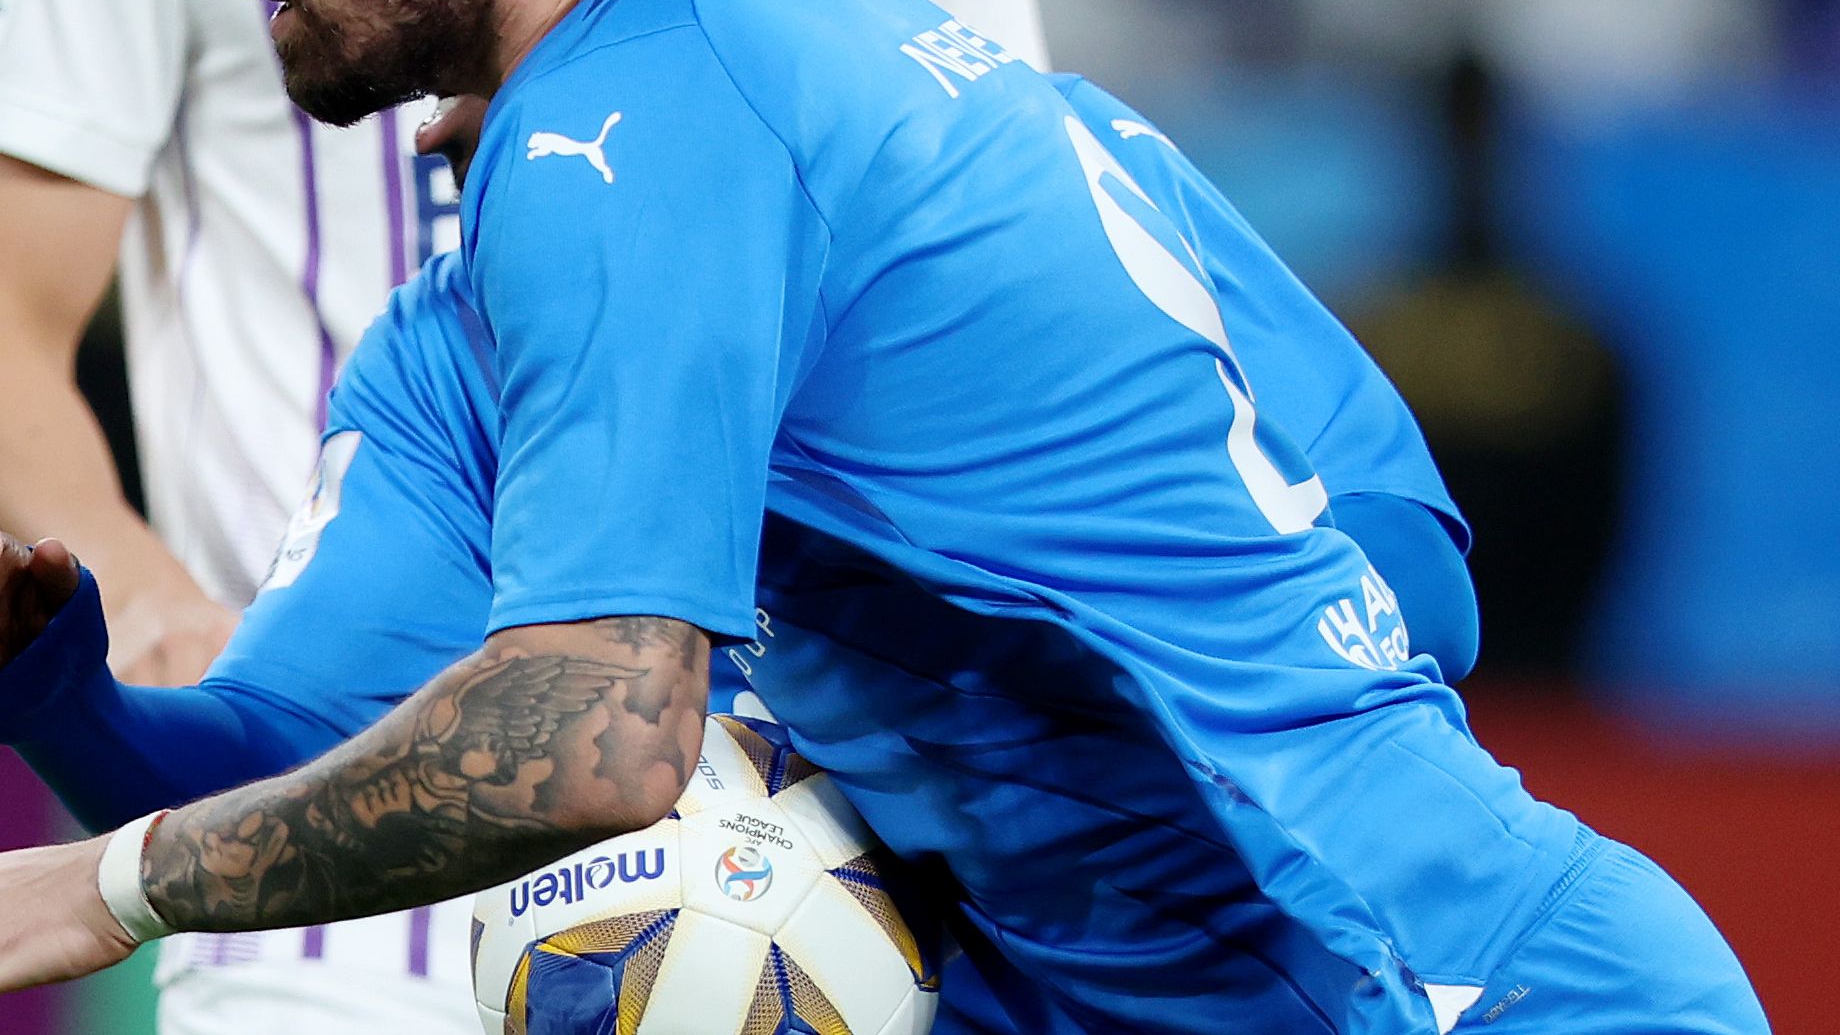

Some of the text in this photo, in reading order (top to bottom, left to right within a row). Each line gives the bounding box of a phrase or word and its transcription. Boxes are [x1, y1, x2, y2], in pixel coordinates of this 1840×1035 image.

[718, 819, 794, 850] CHAMPIONS
[735, 813, 784, 836] LEAGUE
[510, 847, 665, 918] molten
